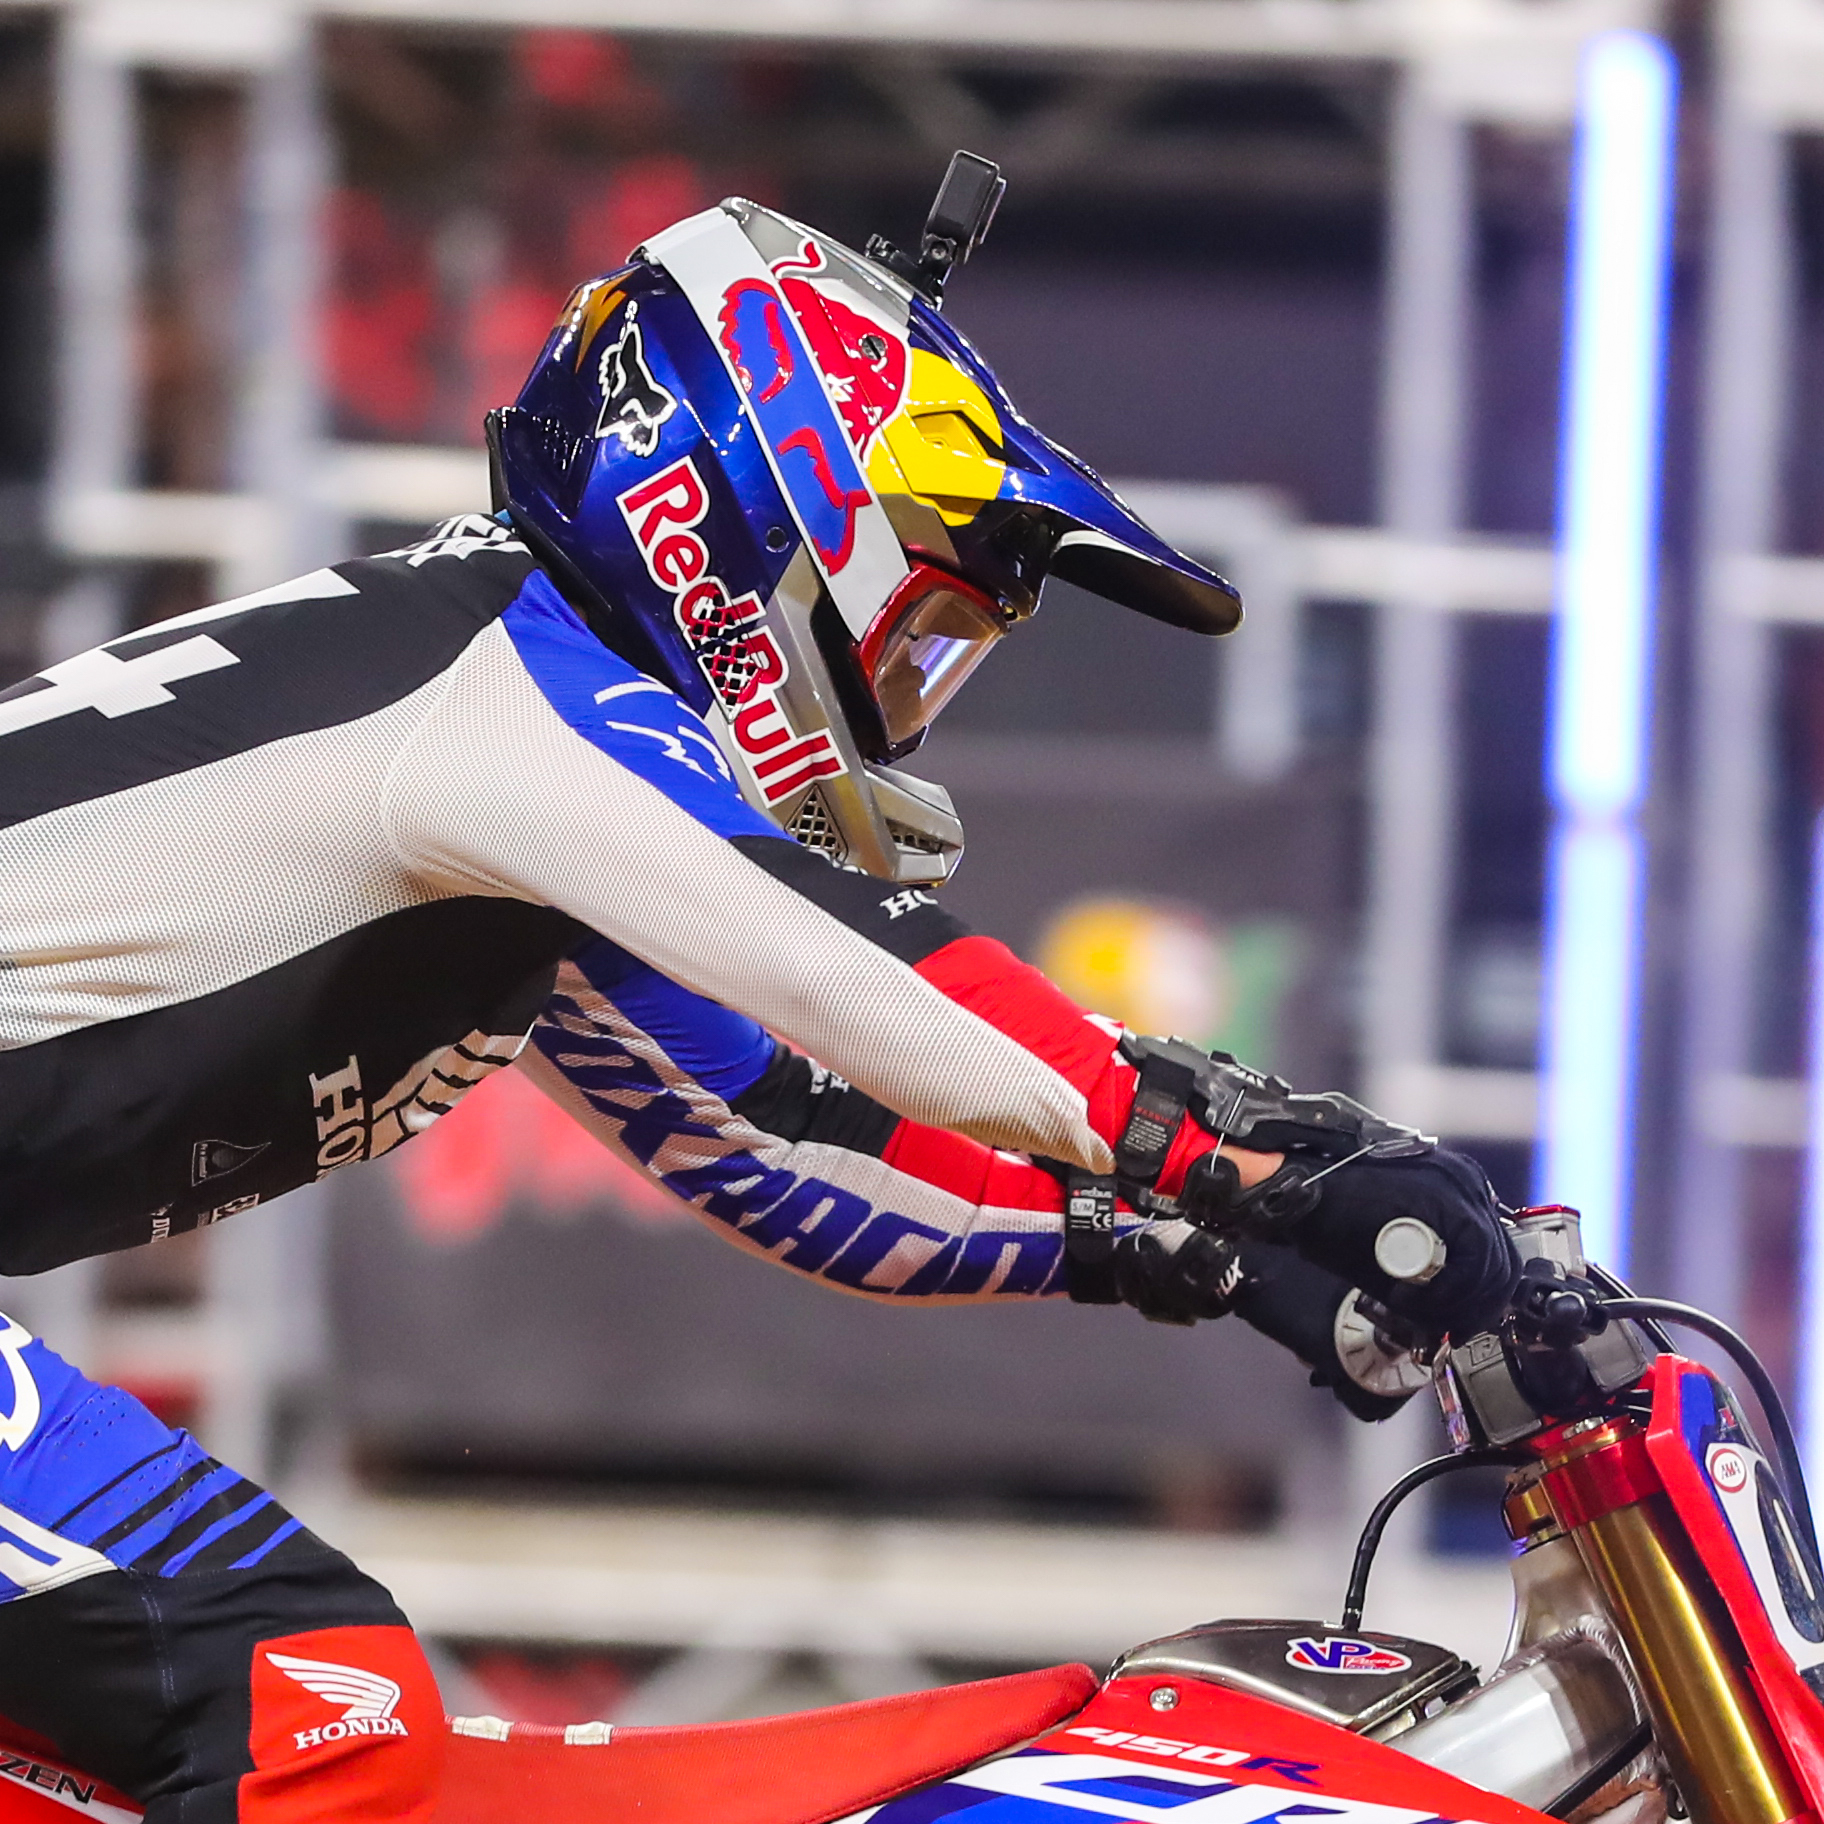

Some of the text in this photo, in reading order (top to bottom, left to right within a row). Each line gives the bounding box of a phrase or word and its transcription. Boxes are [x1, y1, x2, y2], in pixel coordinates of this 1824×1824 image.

[623, 464, 842, 802] Red Bull
[1295, 1640, 1373, 1669] VP
[293, 1714, 409, 1751] HONDA
[1064, 1726, 1322, 1787] 450R
